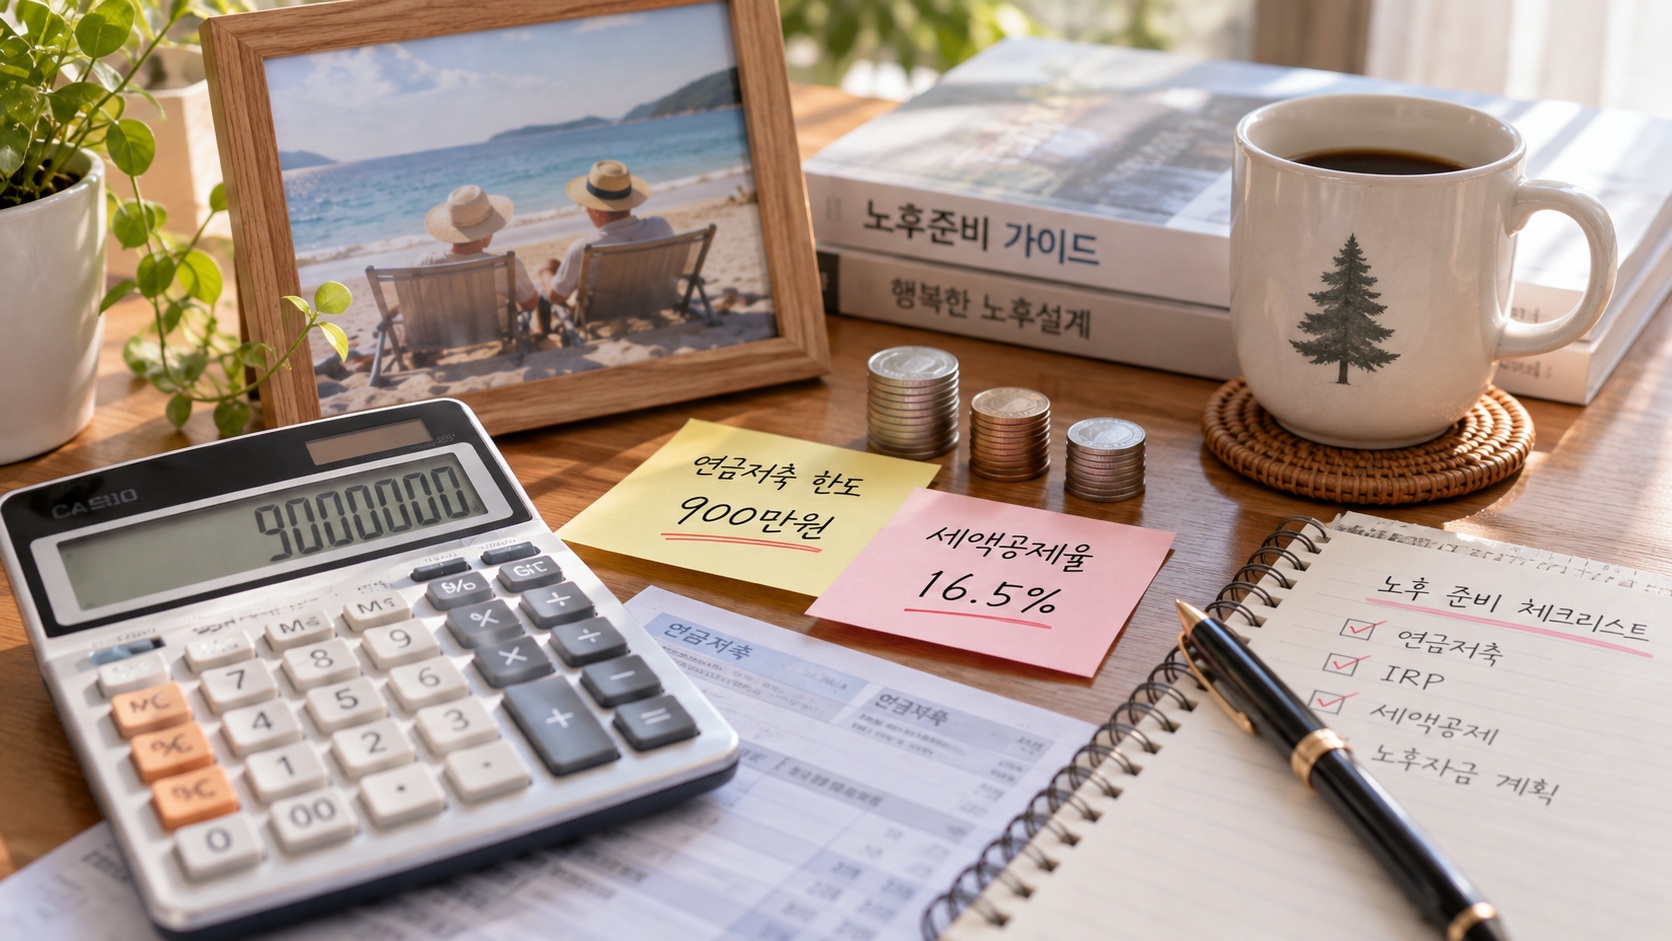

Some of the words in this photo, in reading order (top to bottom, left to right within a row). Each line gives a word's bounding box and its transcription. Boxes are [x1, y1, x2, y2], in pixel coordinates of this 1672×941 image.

[863, 199, 989, 251] 노후준비
[1004, 222, 1100, 266] 가이드
[890, 276, 971, 318] 행복한
[980, 294, 1091, 340] 노후설계
[693, 454, 797, 491] 연금저축
[812, 470, 864, 498] 한도
[254, 465, 471, 562] 9000000
[677, 496, 835, 541] 900만원
[925, 525, 1094, 574] 세액공제율
[918, 570, 1061, 615] 16.5%
[1377, 575, 1430, 602] 노후
[1446, 585, 1502, 613] 준비
[1517, 598, 1650, 642] 체크리스트
[388, 628, 412, 650] 9
[663, 622, 754, 661] 연금저축
[1397, 629, 1504, 667] 연금저축
[309, 649, 333, 669] 8
[225, 668, 246, 691] 7
[417, 667, 441, 688] 6
[1379, 664, 1446, 691] IRP
[334, 688, 358, 711] 5
[251, 711, 273, 732] 4
[443, 708, 470, 732] 3
[1369, 704, 1500, 746] 세액공제
[360, 730, 387, 754] 2
[275, 755, 295, 777] 1
[1370, 744, 1479, 786] 노후자금
[1495, 774, 1560, 806] 계획
[289, 799, 337, 829] 00
[205, 826, 233, 853] 0
